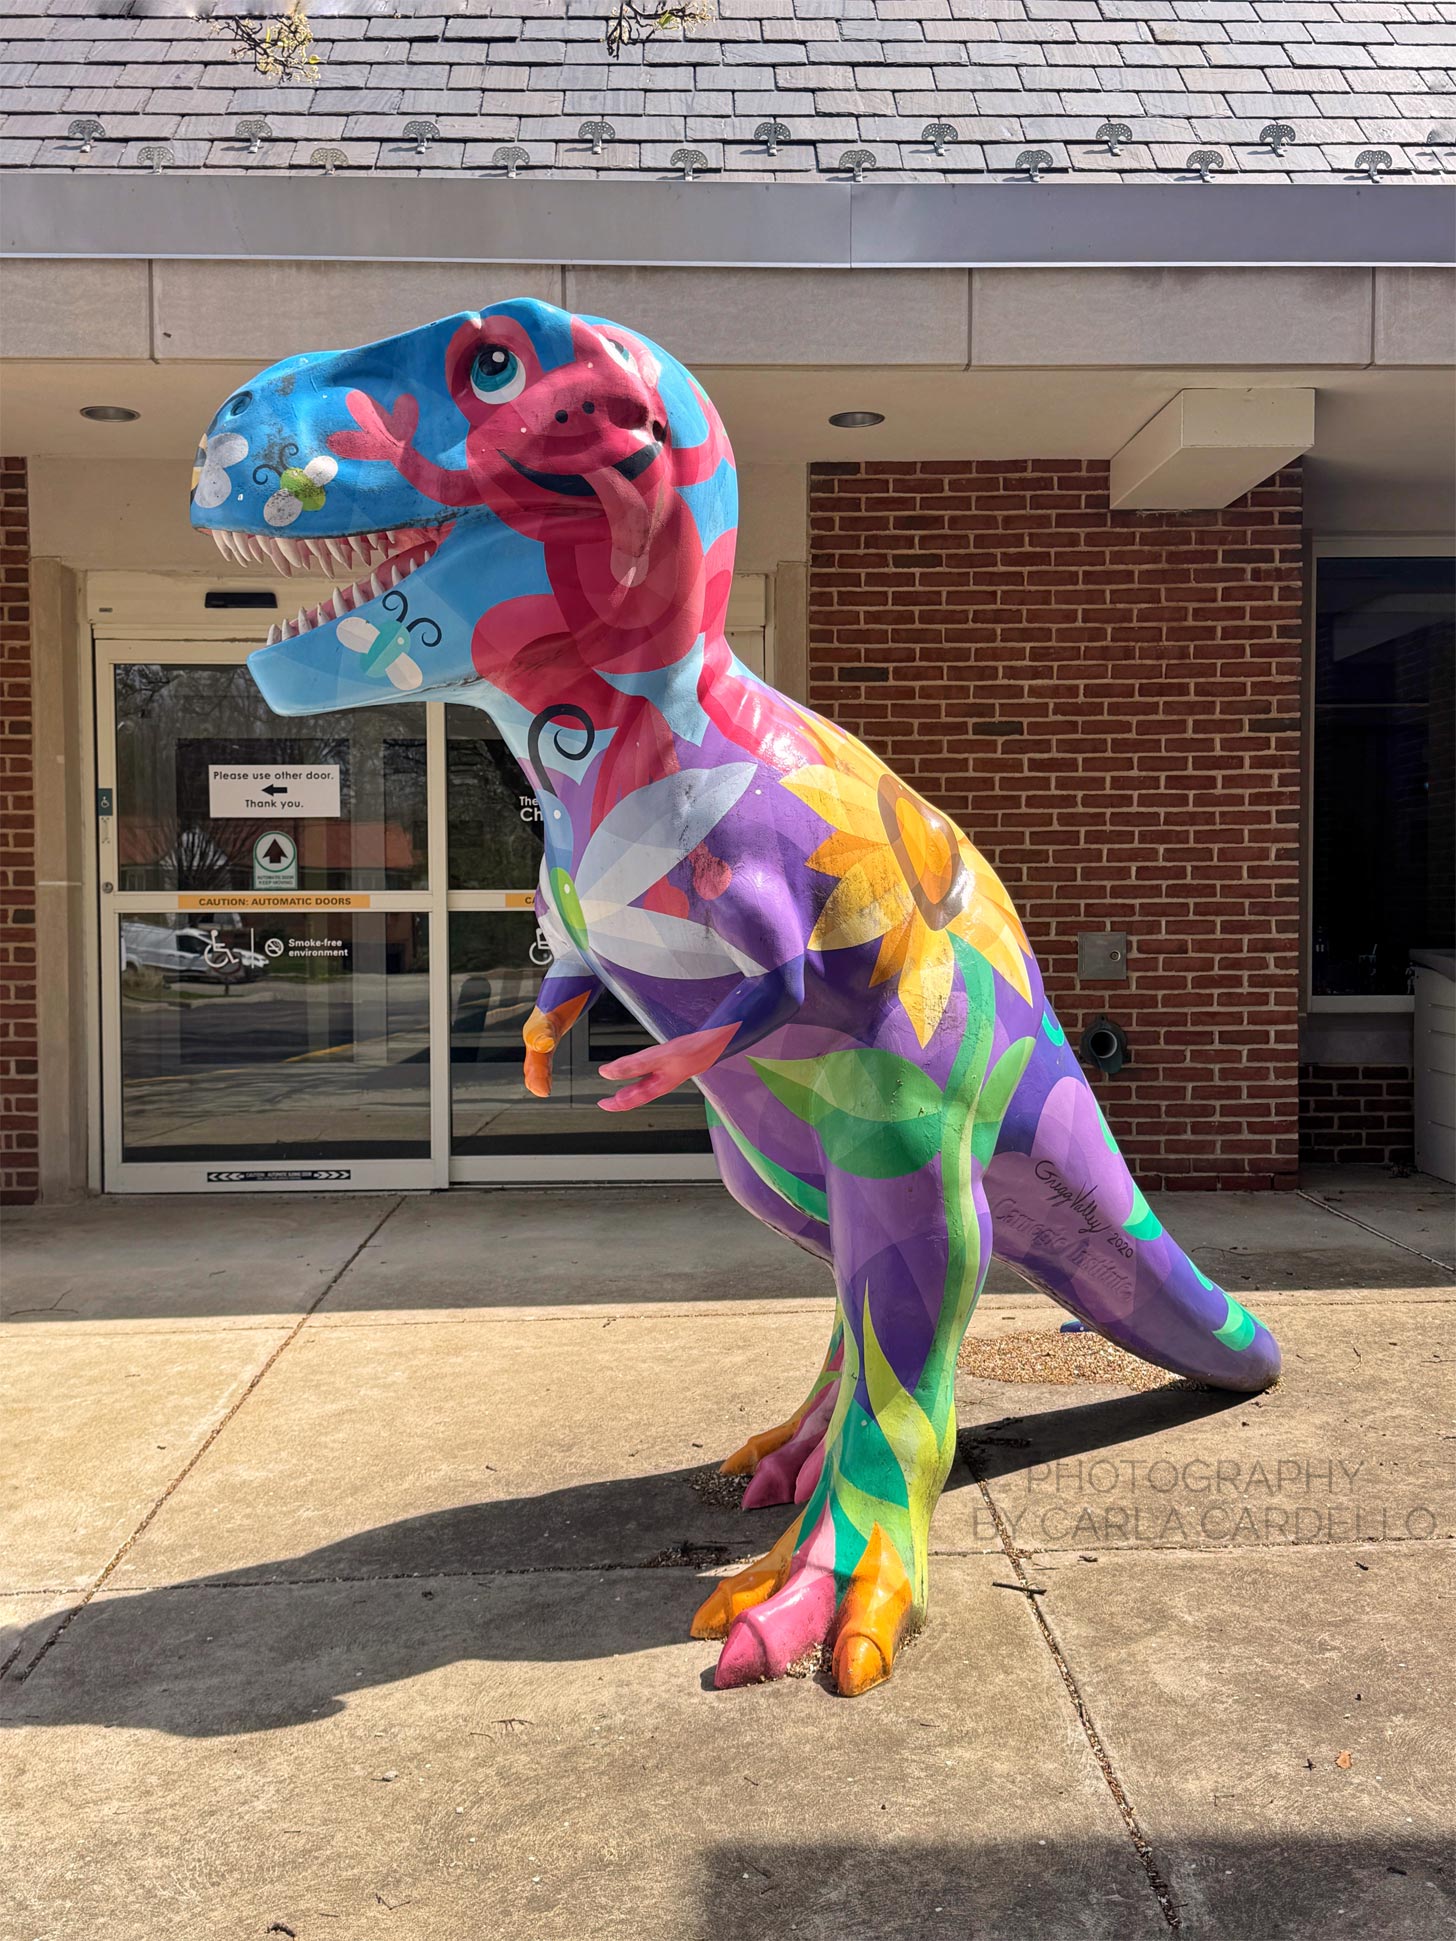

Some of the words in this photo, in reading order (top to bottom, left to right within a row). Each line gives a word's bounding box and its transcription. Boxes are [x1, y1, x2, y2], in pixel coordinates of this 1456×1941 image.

[213, 771, 249, 781] Please
[252, 772, 271, 781] use
[274, 771, 303, 781] other
[305, 771, 334, 780] door.
[245, 799, 277, 809] Thank
[280, 801, 304, 811] you.
[519, 796, 539, 806] The
[198, 898, 249, 906] CAUTION:
[251, 897, 313, 905] AUTOMATIC
[315, 897, 352, 905] DOORS
[288, 938, 343, 948] Smoke-free
[288, 949, 349, 957] environment
[1107, 1232, 1134, 1259] 2020
[1063, 1237, 1133, 1300] Institute
